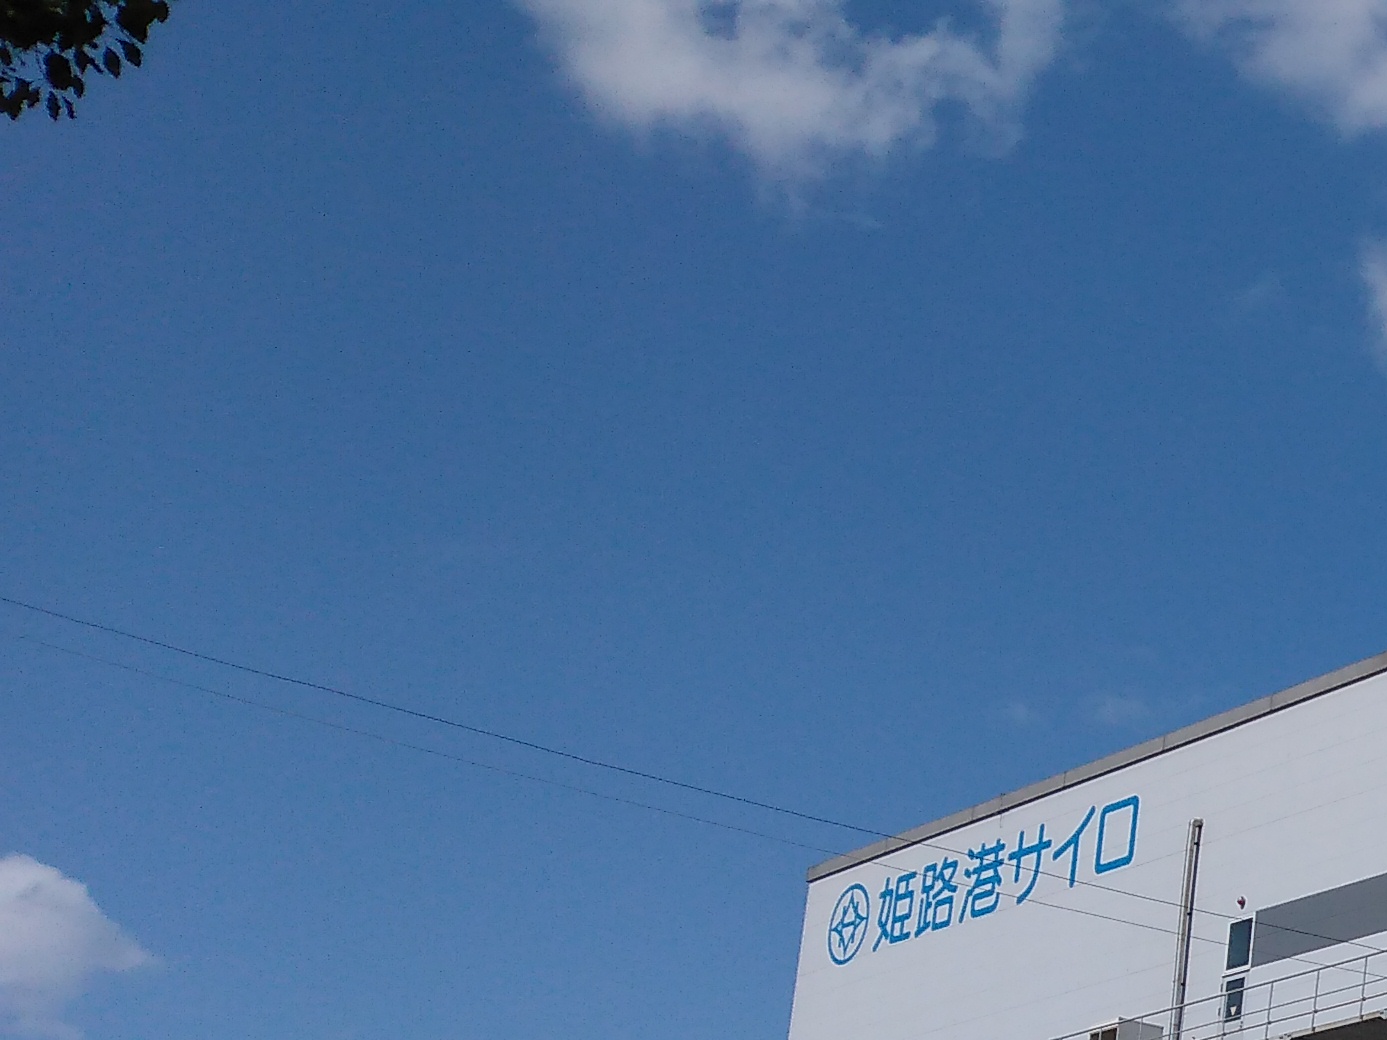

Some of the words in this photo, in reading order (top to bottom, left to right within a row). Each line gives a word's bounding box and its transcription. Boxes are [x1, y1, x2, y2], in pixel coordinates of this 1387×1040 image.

[872, 795, 1140, 952] 姫路港サイロ
